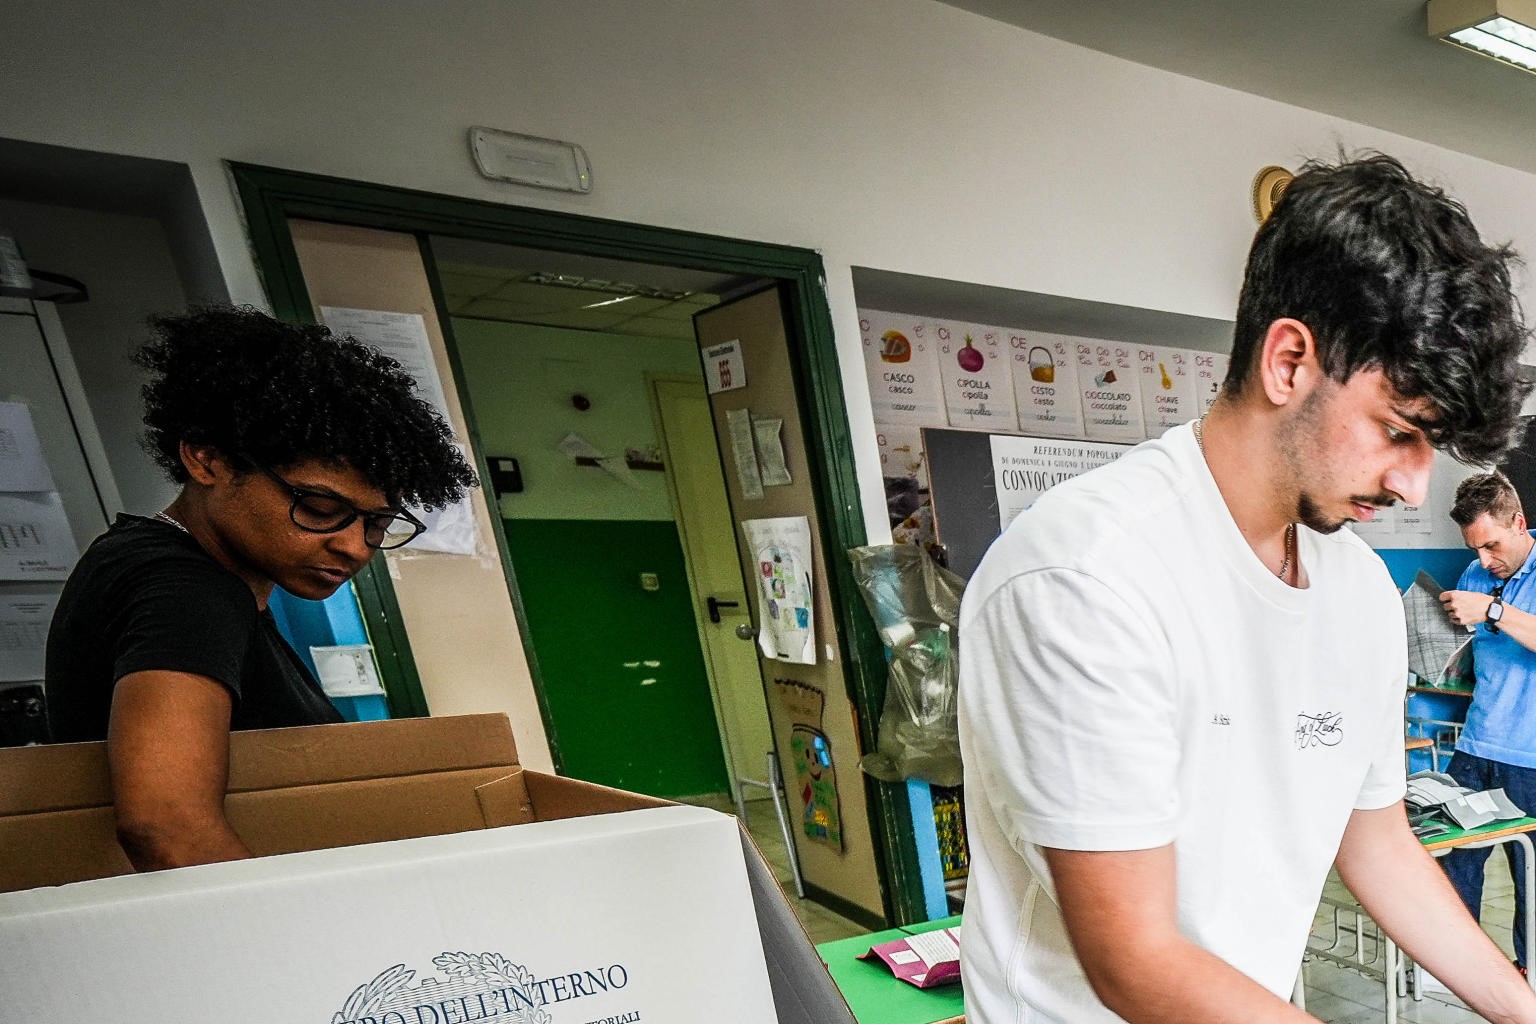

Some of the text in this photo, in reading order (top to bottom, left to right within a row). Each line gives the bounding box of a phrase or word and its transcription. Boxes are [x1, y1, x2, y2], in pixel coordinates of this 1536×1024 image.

[1010, 336, 1027, 350] CE
[1138, 350, 1155, 362] CHI
[1194, 355, 1214, 368] CHE
[883, 372, 915, 384] CASCO
[956, 378, 992, 390] CIPOLLA
[888, 386, 914, 394] casco
[962, 391, 989, 401] cipolla
[1031, 386, 1055, 396] CESTO
[1085, 390, 1131, 402] CIOCCOLATO
[1033, 398, 1055, 406] cesto
[1155, 395, 1179, 405] CHIAVE
[1091, 402, 1127, 412] cioccolato
[1158, 406, 1178, 414] chiave
[1033, 446, 1123, 461] REFERENDUM POPOLAR
[1011, 457, 1045, 467] DOMENICA
[1054, 460, 1078, 470] GIUGNO
